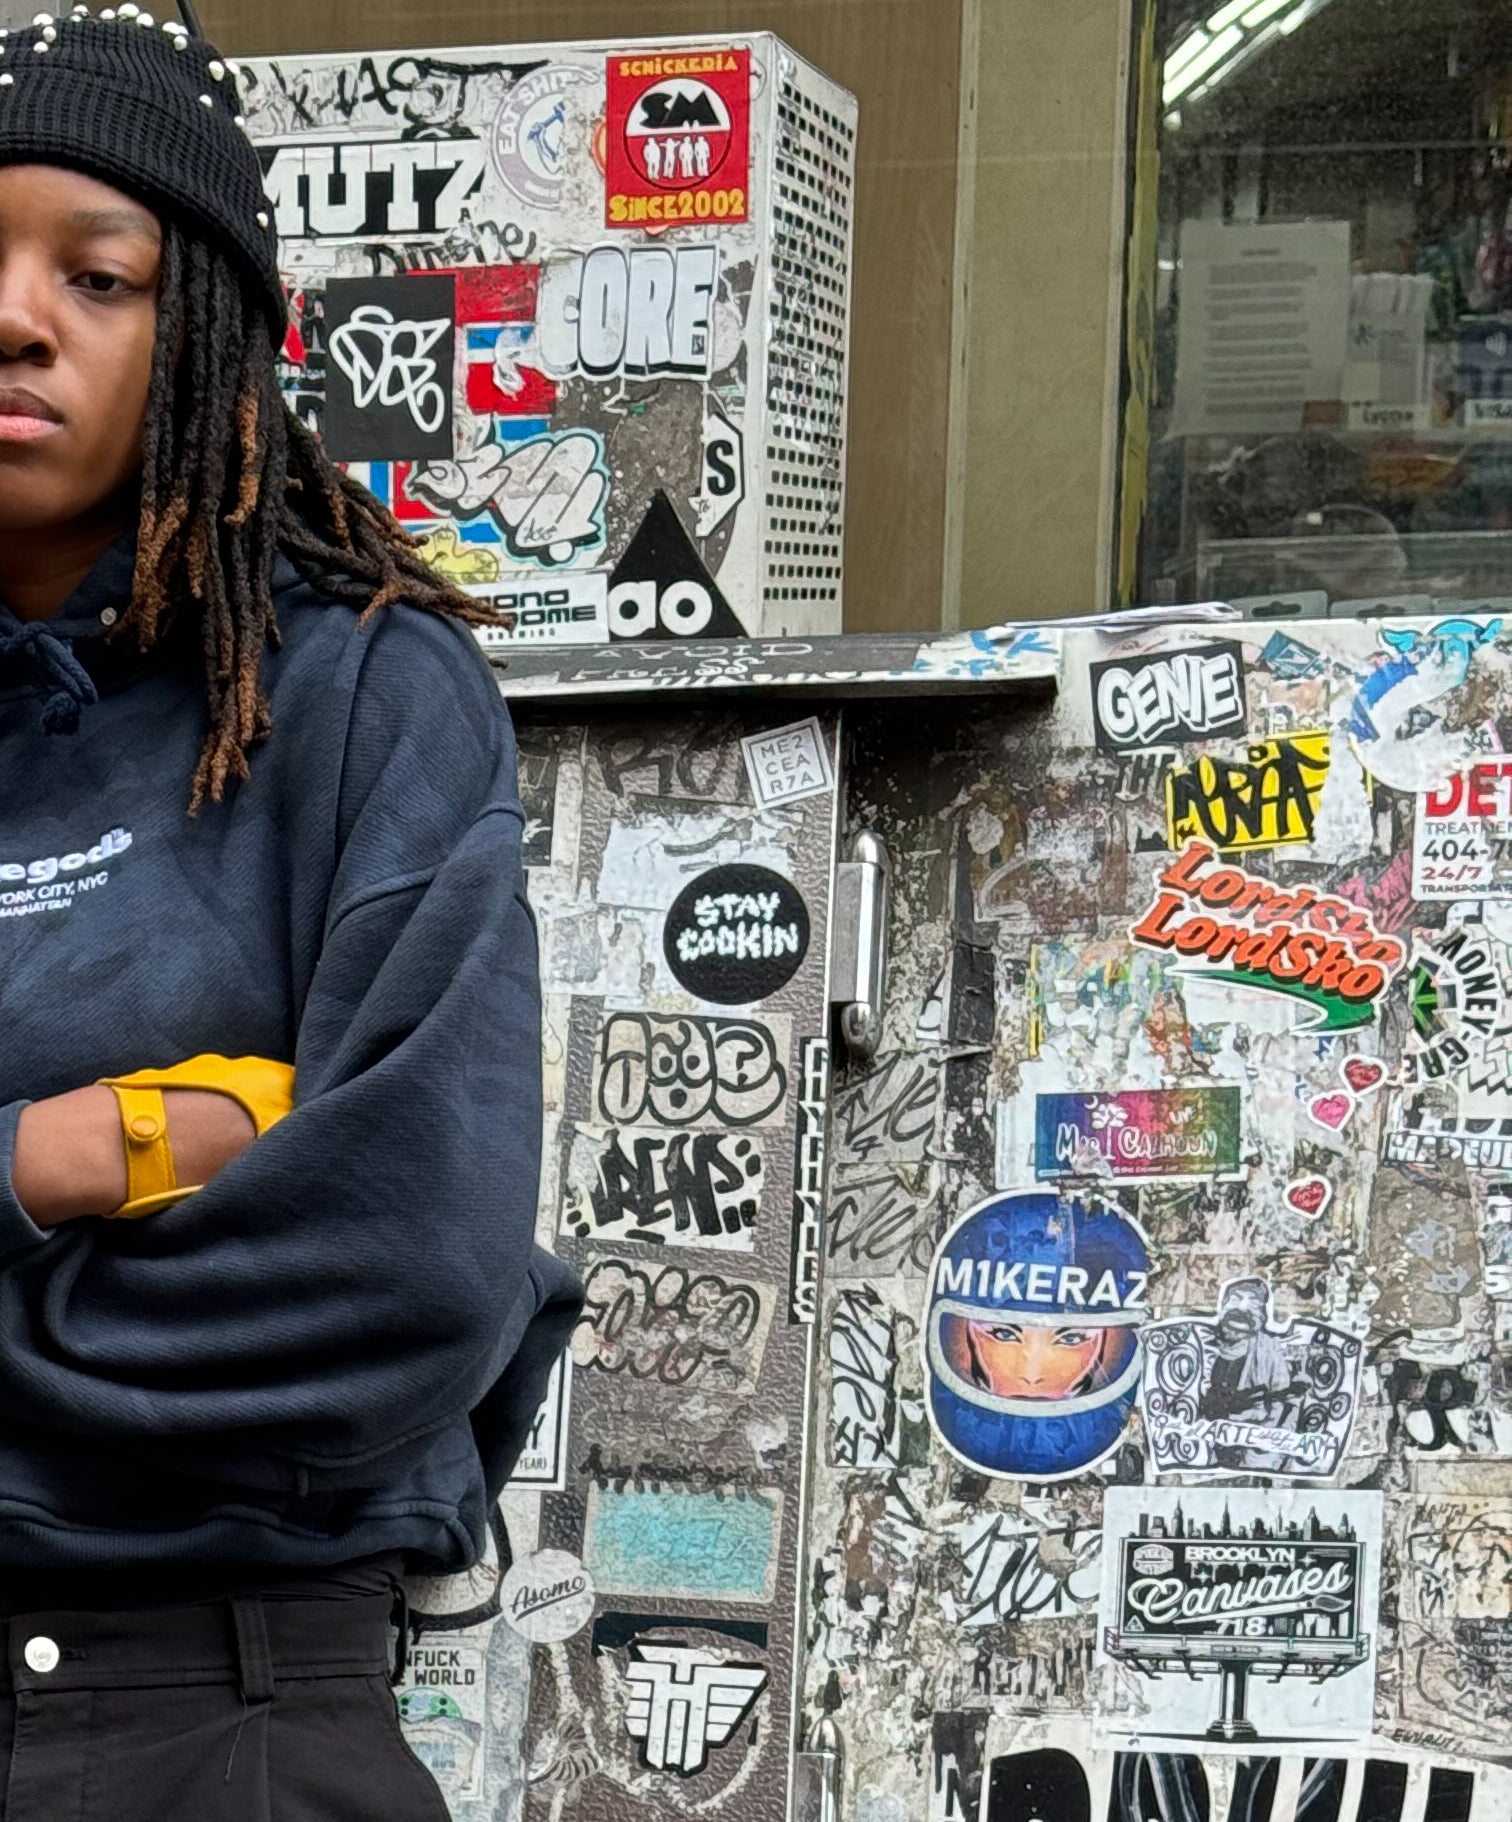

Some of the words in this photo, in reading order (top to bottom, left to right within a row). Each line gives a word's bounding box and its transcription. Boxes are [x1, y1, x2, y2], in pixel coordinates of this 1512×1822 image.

[1098, 654, 1243, 744] GENIE
[759, 735, 807, 759] ME2
[764, 753, 811, 776] CEA
[77, 870, 109, 893] NYC
[1420, 864, 1483, 881] 24/7
[694, 892, 781, 928] STAY
[675, 920, 800, 962] COOKIN
[1184, 1546, 1296, 1563] BROOKLYN
[1127, 1561, 1354, 1625] Canvases
[1215, 1616, 1267, 1637] 718
[408, 1650, 461, 1667] NFUCK
[414, 1668, 475, 1686] WORLD
